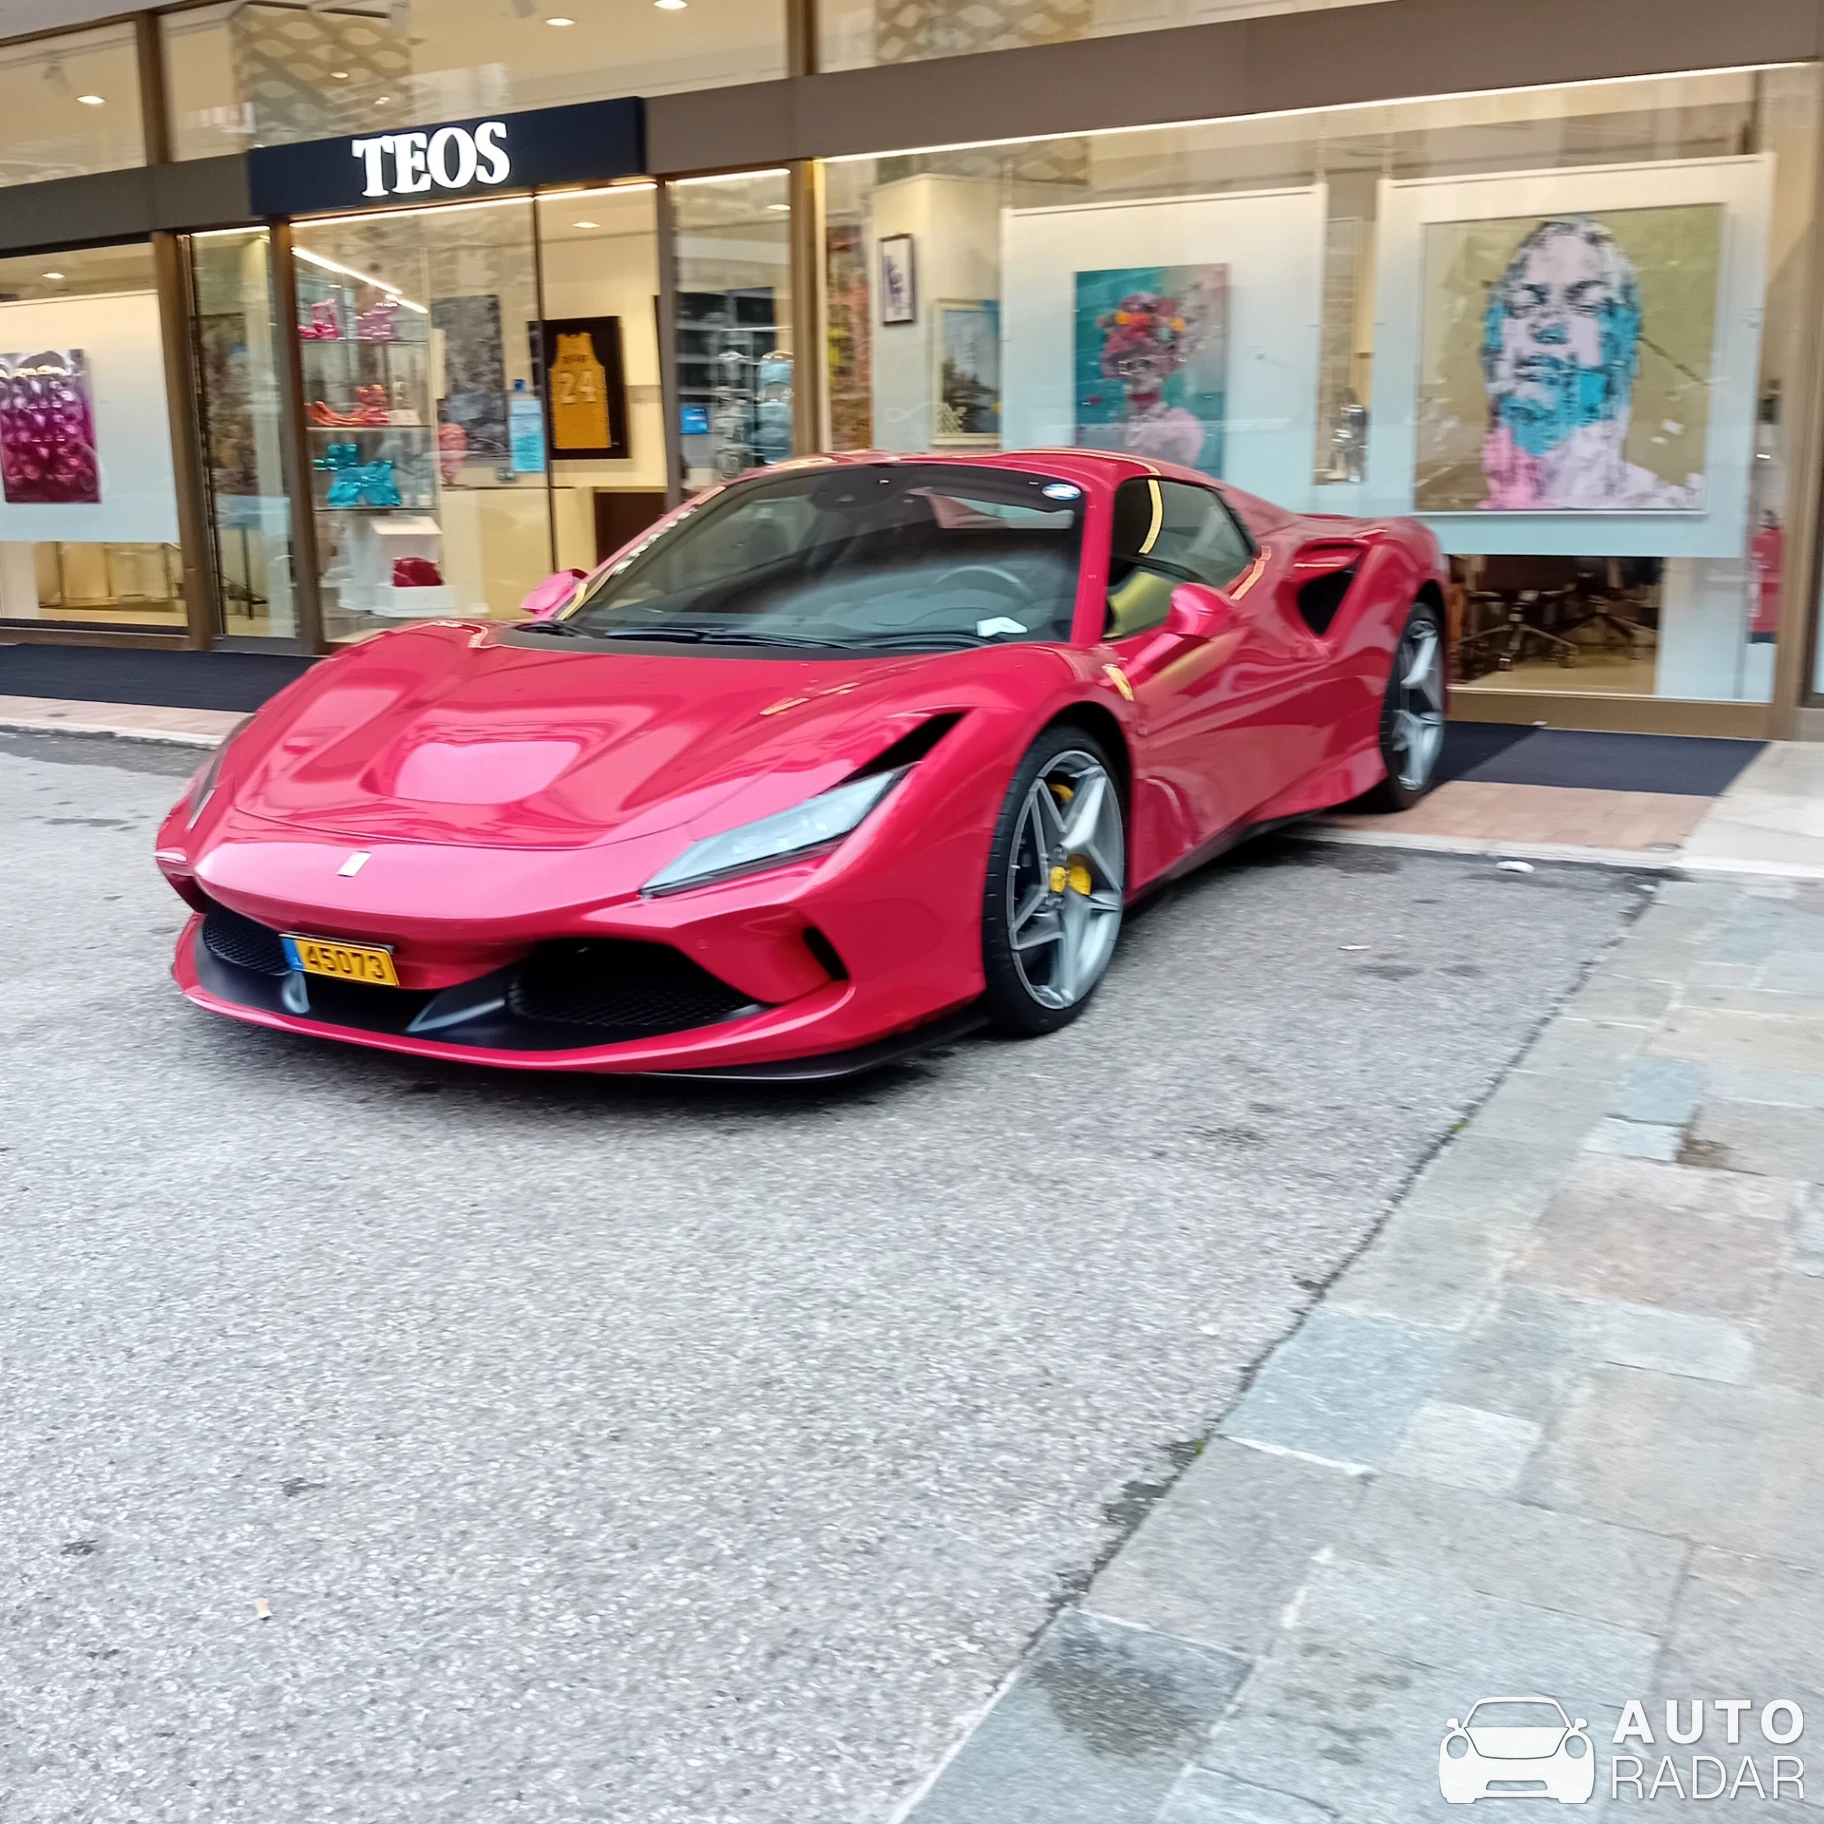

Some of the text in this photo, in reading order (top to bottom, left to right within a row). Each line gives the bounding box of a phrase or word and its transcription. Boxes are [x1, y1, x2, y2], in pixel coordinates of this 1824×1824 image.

[351, 121, 512, 197] TEOS
[556, 368, 597, 405] 24
[307, 945, 385, 979] 45073
